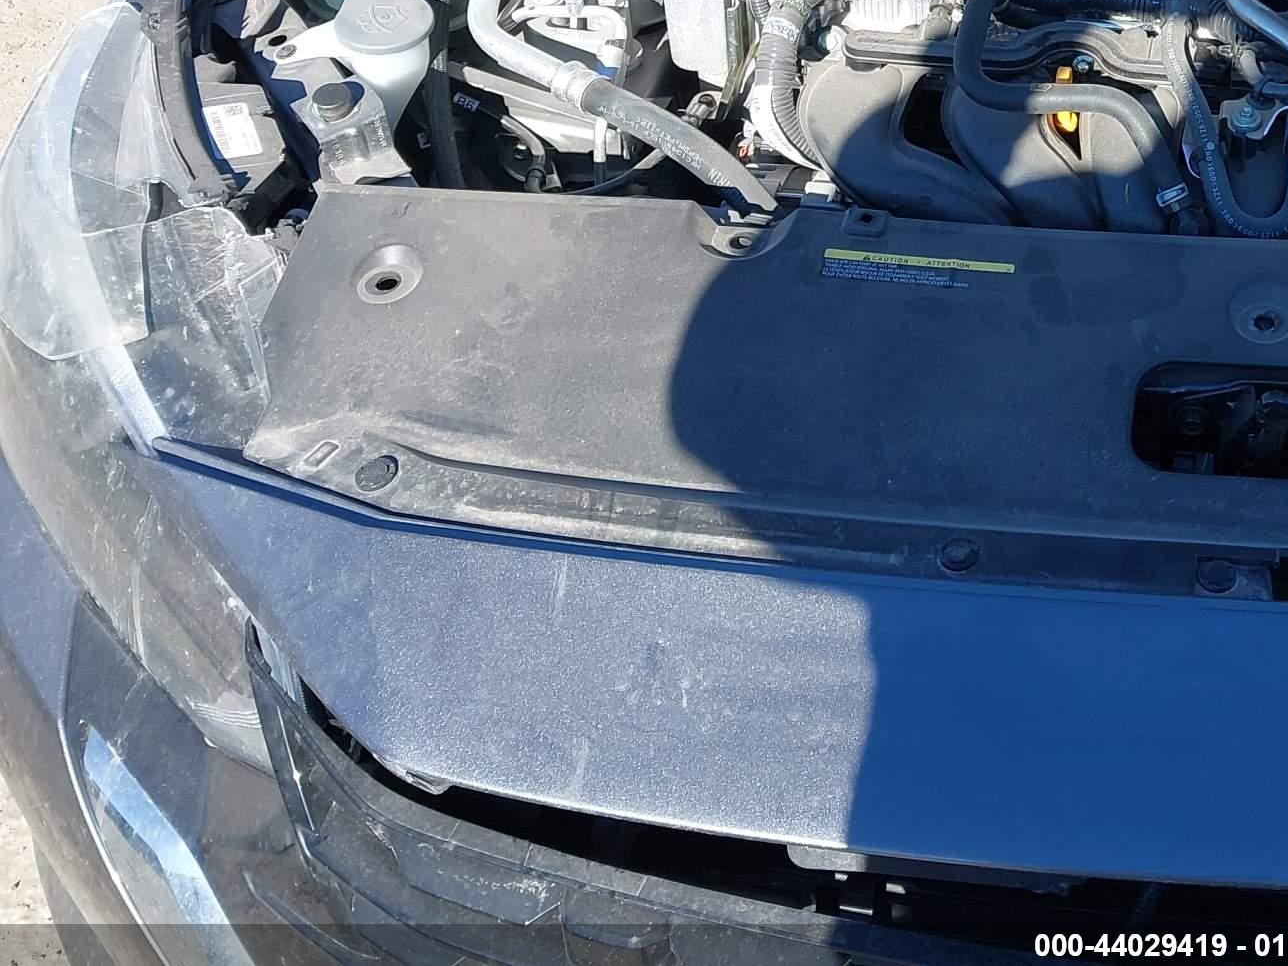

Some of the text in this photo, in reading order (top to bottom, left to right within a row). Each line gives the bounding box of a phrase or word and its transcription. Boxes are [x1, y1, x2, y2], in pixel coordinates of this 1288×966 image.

[456, 95, 475, 110] B6
[872, 256, 909, 264] CAUTION
[926, 260, 971, 269] ATTENTION
